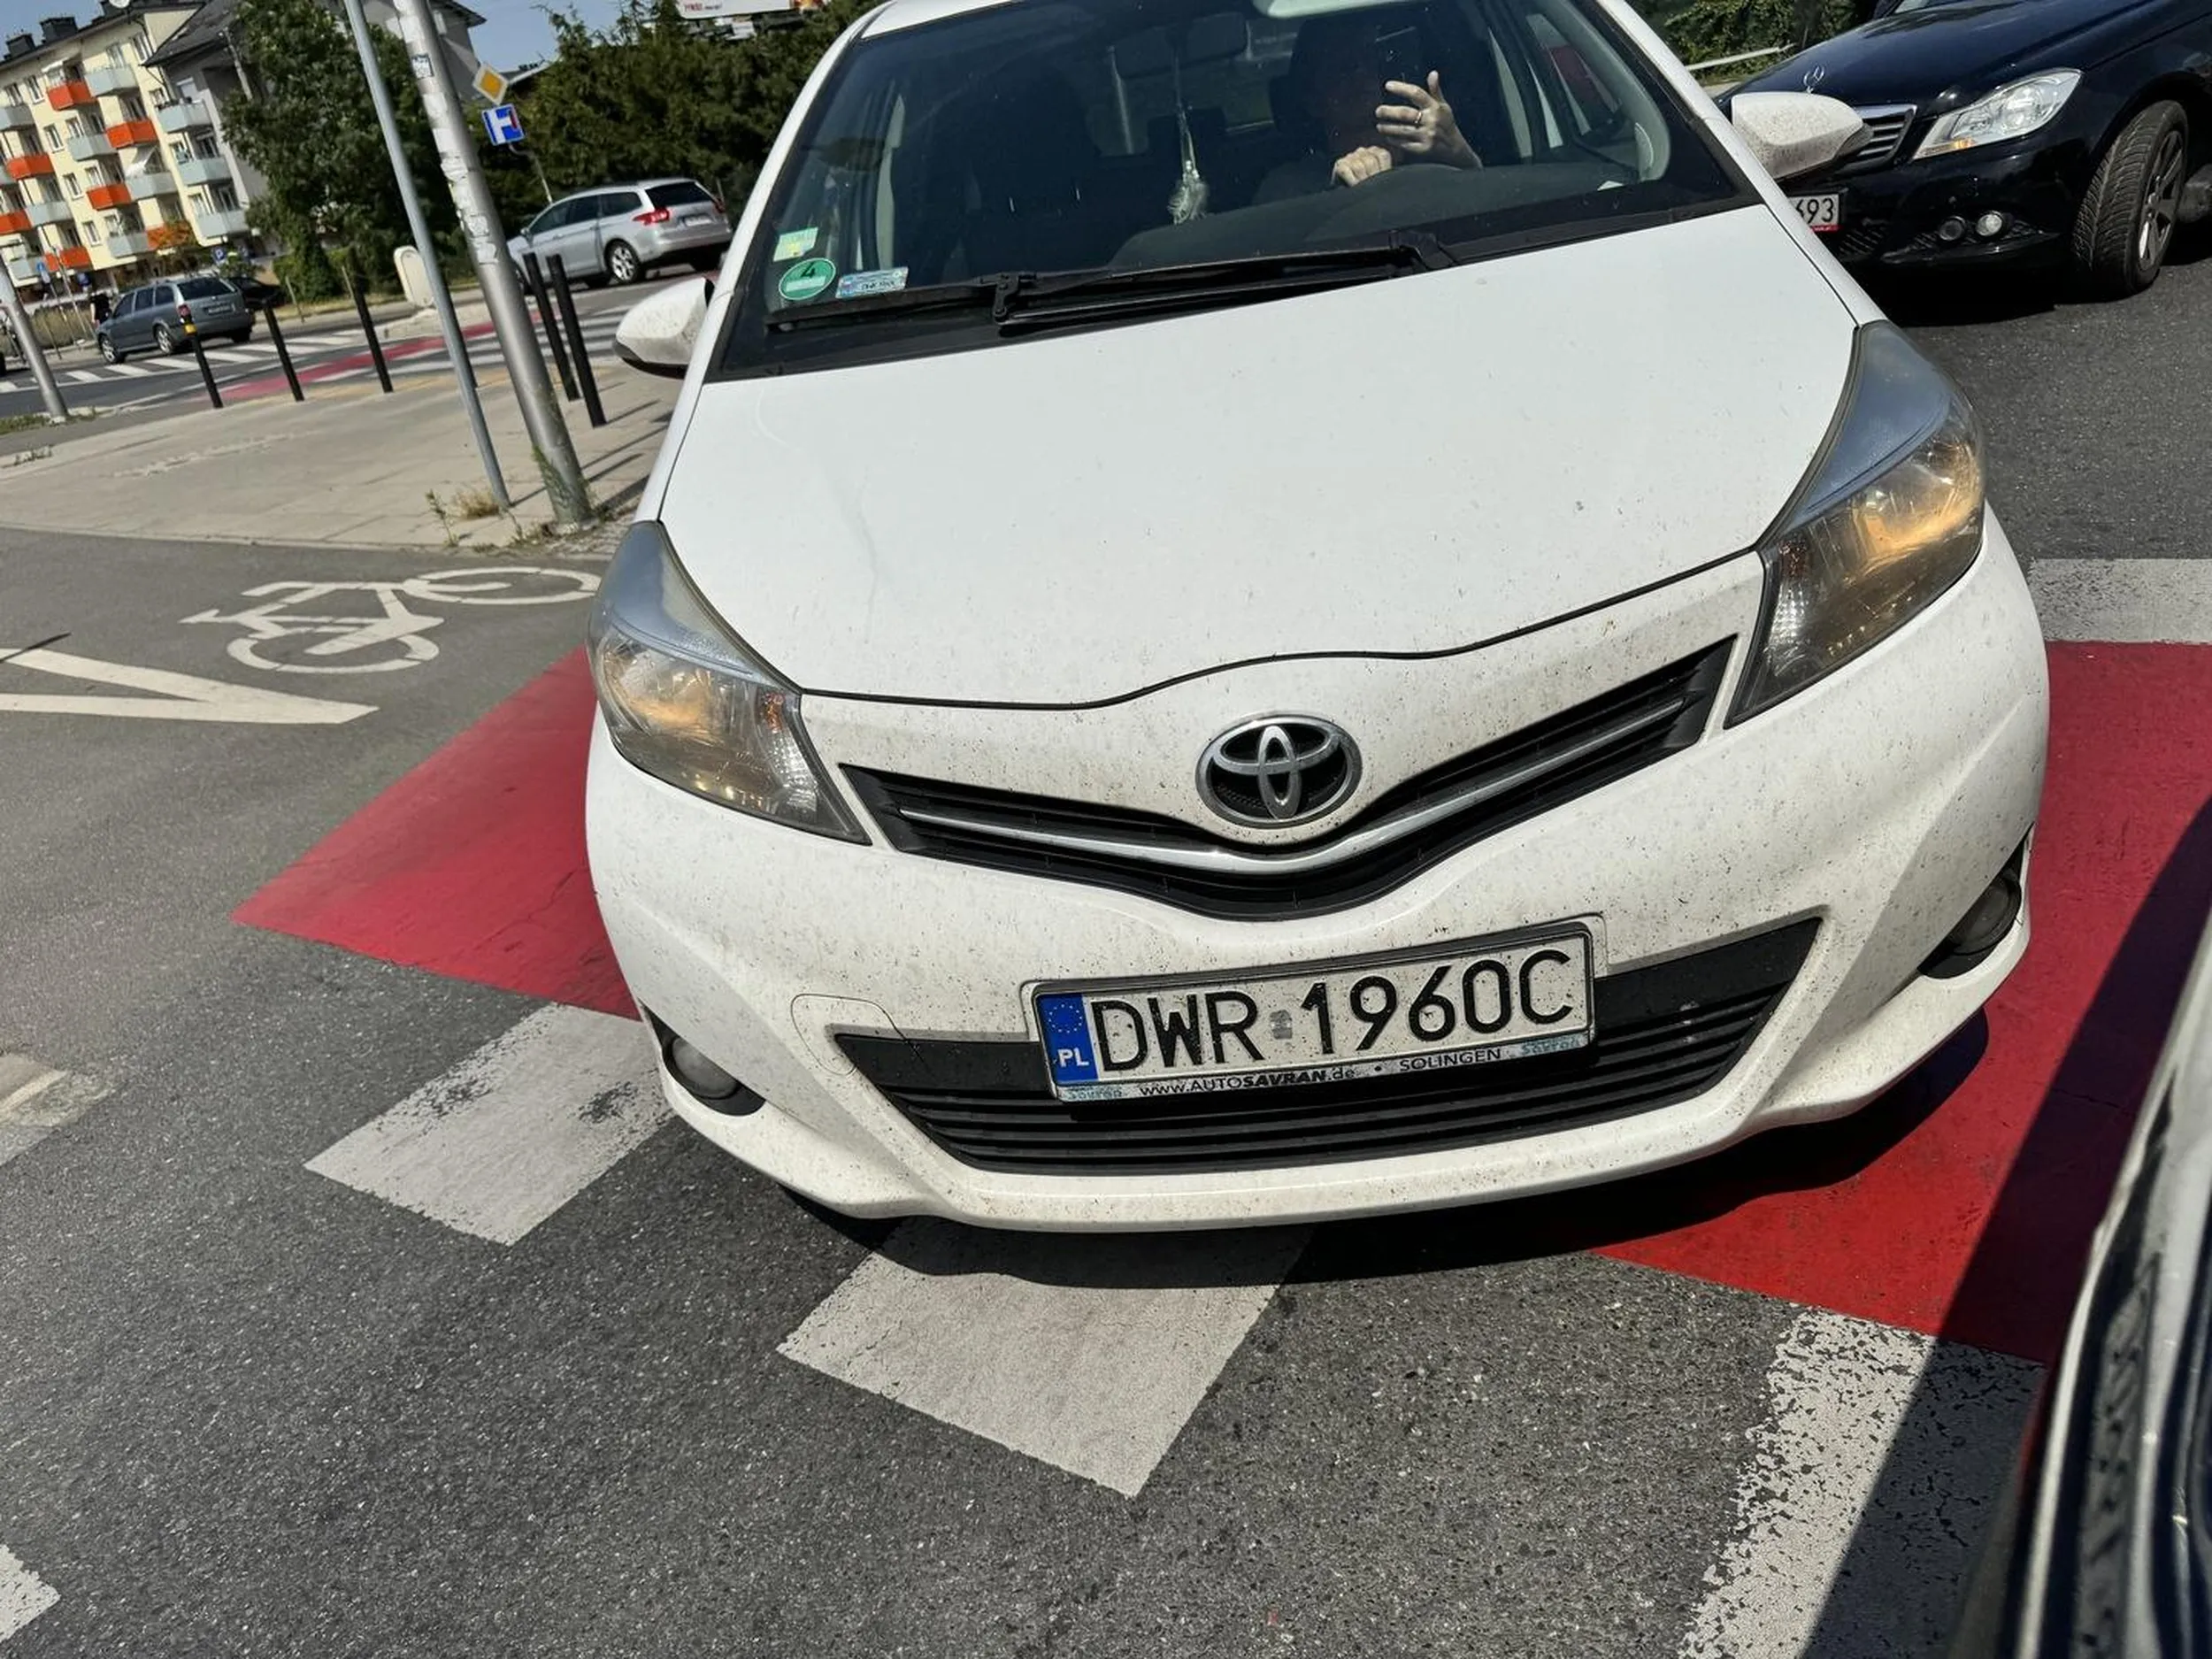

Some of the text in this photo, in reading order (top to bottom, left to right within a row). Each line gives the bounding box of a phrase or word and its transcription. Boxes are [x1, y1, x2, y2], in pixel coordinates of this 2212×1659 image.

[1091, 949, 1572, 1072] DWR 1960C
[1057, 1048, 1089, 1068] PL
[1141, 1048, 1502, 1096] www.AUTOSAVRAN.de SOLINGEN
